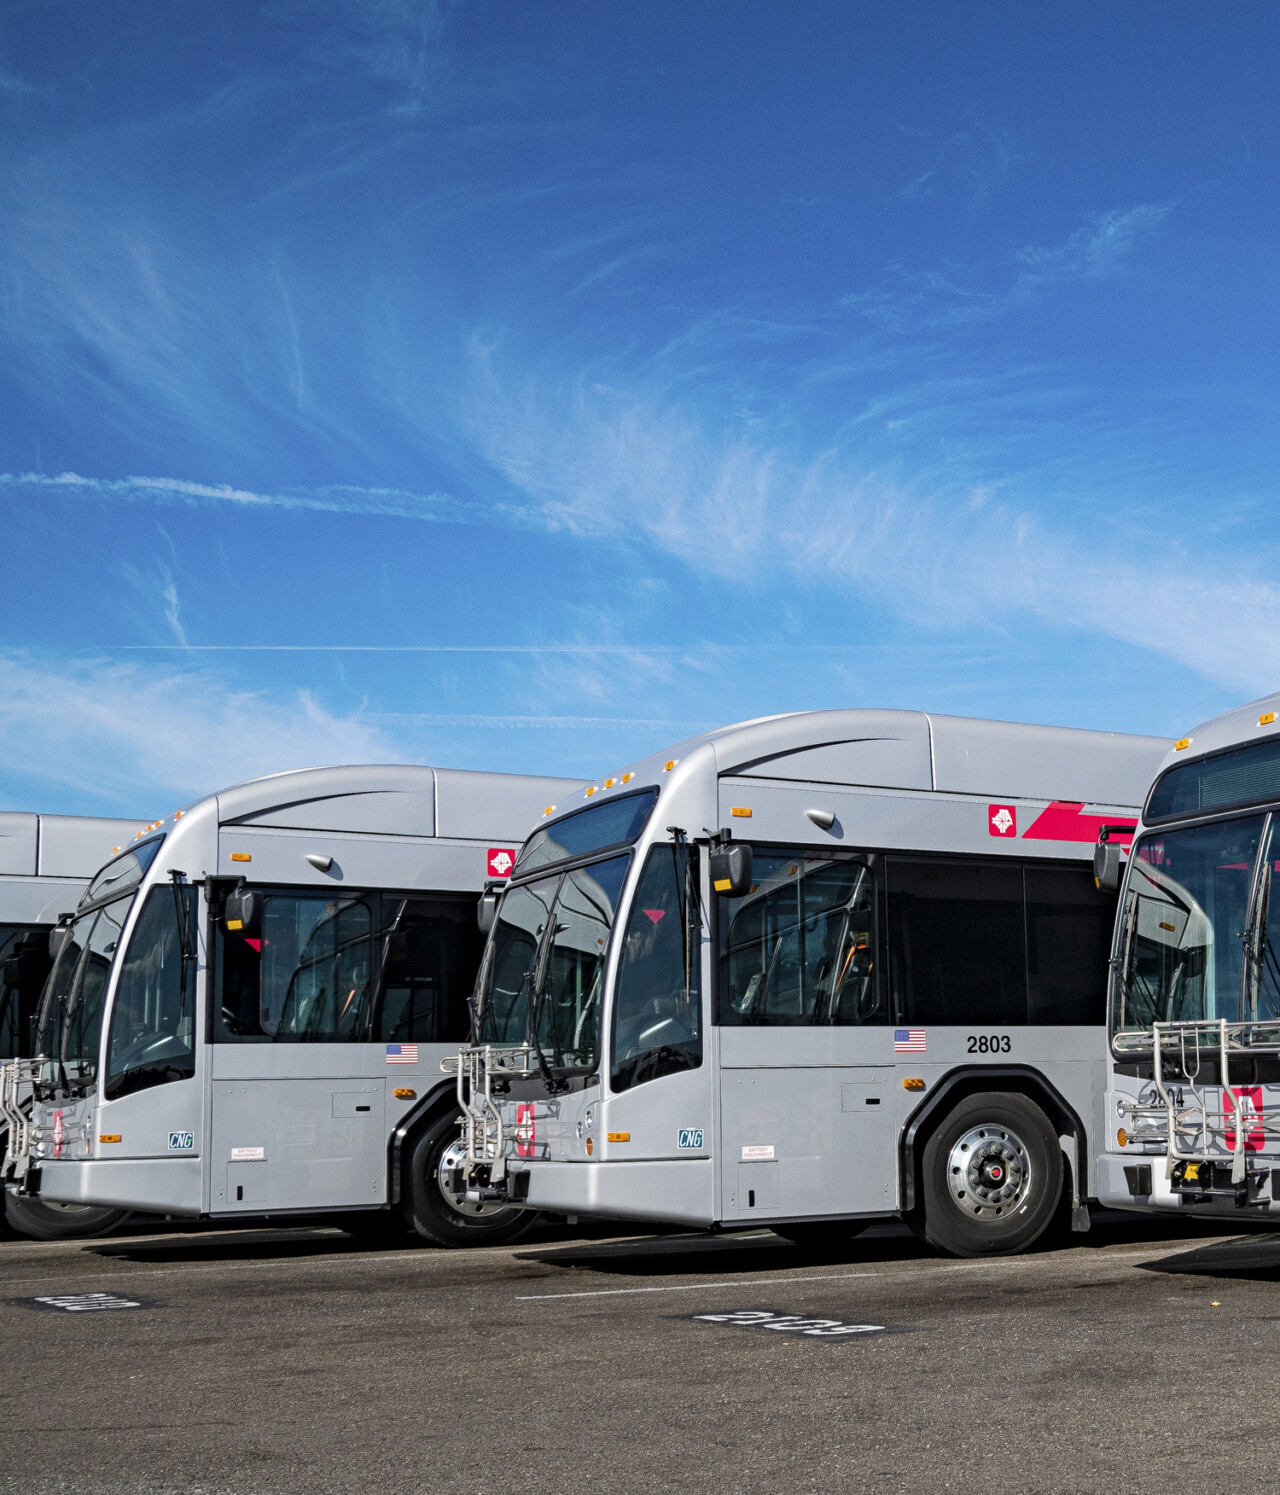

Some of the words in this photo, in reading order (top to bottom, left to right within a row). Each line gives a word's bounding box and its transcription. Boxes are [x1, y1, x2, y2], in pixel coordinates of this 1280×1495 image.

[967, 1035, 1012, 1054] 2803
[169, 1133, 193, 1148] CNG
[679, 1130, 703, 1147] CNG
[692, 1311, 886, 1335] 2109
